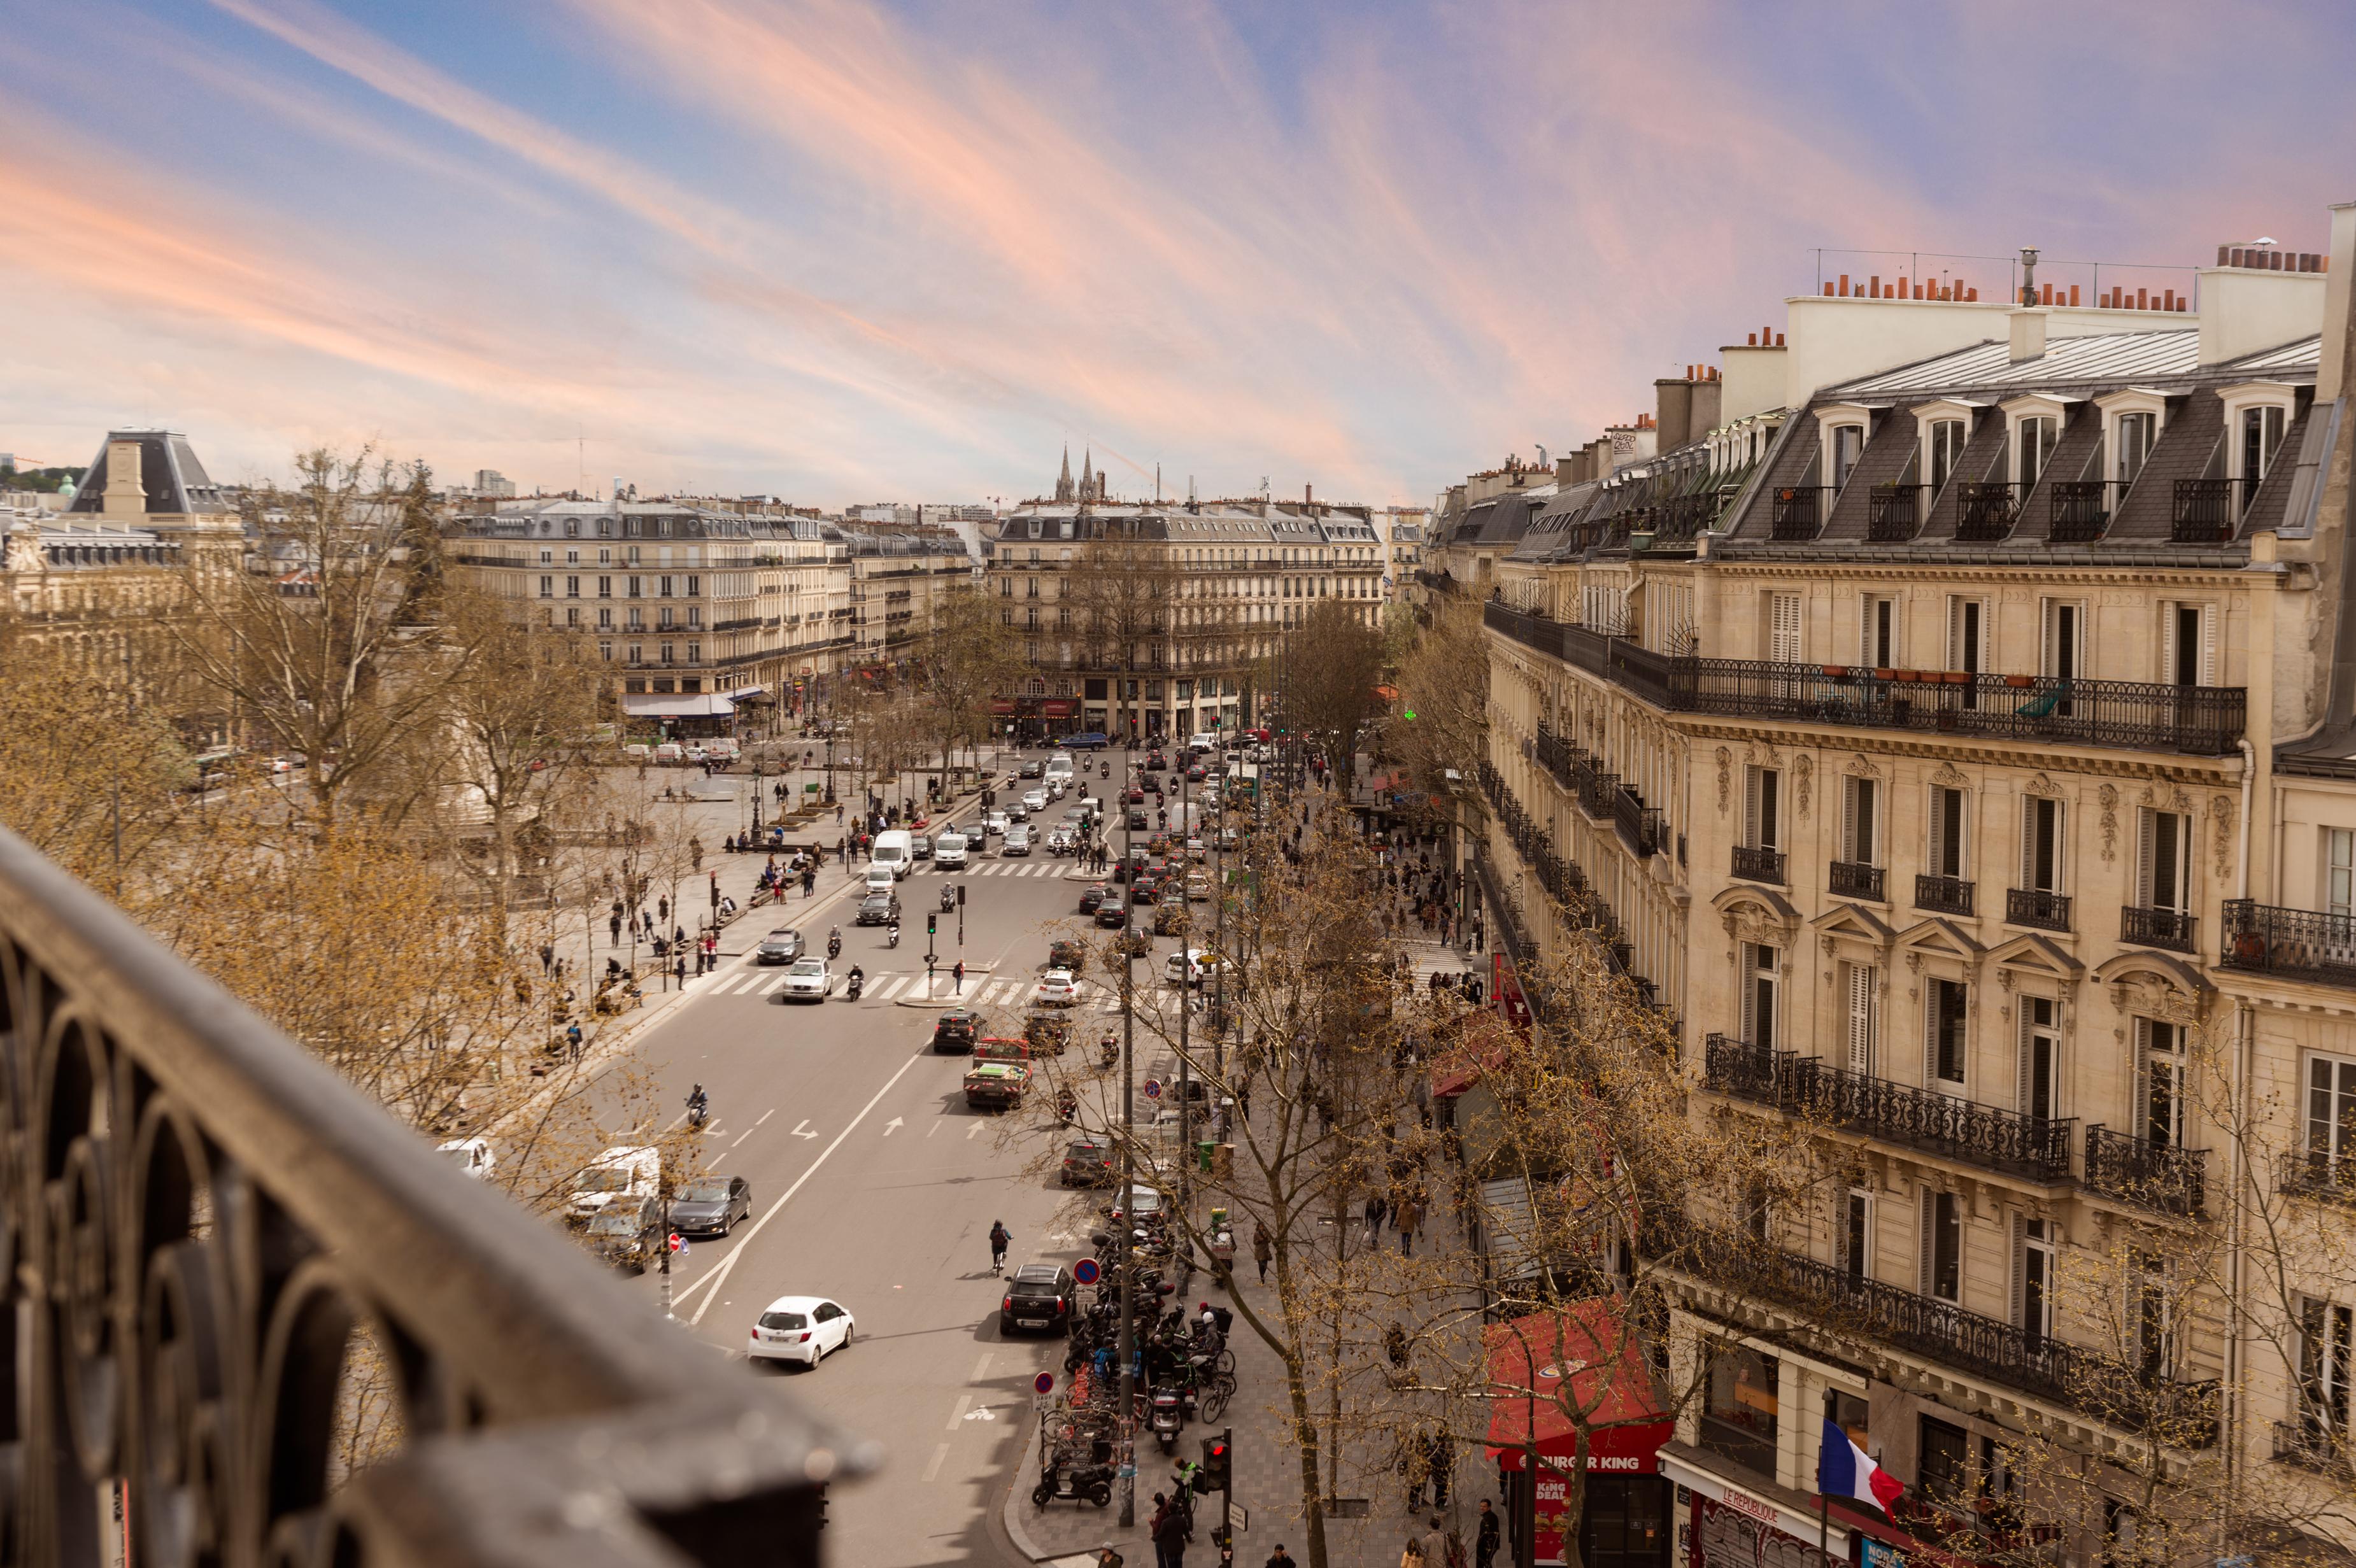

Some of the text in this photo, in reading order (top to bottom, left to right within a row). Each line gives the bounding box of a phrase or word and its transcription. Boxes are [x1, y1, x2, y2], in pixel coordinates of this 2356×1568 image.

[1601, 1457, 1639, 1469] KING
[1723, 1487, 1733, 1502] LE
[1869, 1545, 1897, 1565] NORA
